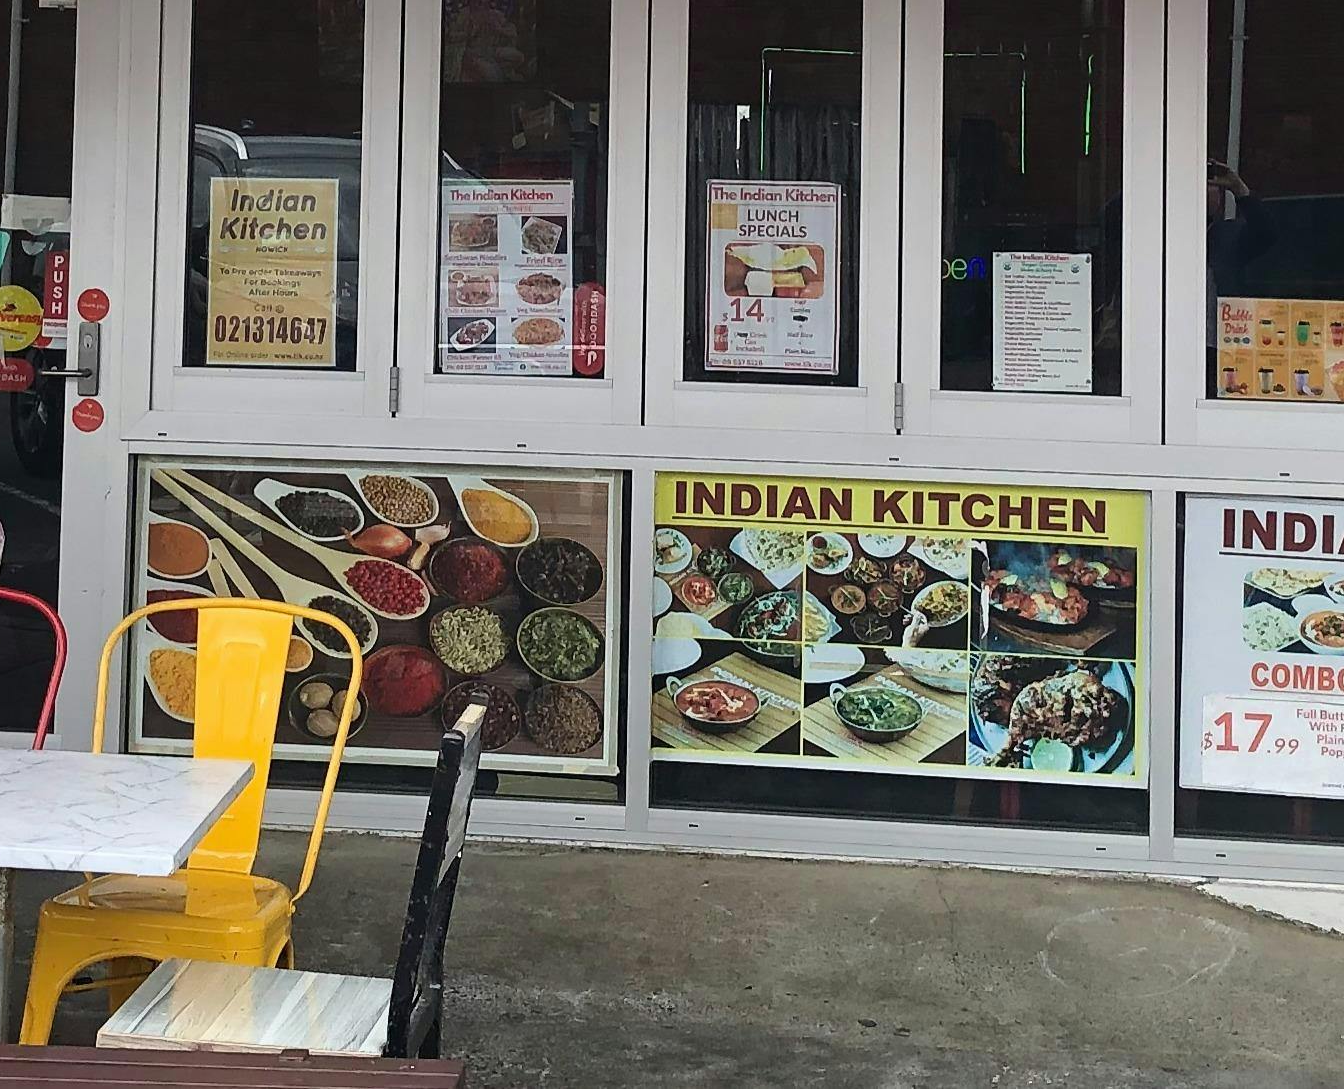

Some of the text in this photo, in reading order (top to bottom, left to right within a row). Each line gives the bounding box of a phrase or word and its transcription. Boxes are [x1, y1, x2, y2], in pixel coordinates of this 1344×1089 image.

[231, 189, 317, 212] Indian
[450, 188, 554, 201] The Indian Kitchen
[712, 187, 836, 203] The Indian Kitchen
[747, 209, 799, 223] LUNCH
[219, 216, 327, 240] Kitchen
[738, 224, 807, 238] SPECIALS
[51, 255, 65, 315] PUSH
[272, 289, 299, 297] Hours
[214, 315, 327, 344] 021314647
[674, 480, 1107, 534] INDIAN KITCHEN
[1296, 708, 1317, 720] Full
[1204, 711, 1300, 755] $17.99
[1309, 721, 1338, 732] With
[1316, 735, 1344, 746] Plain
